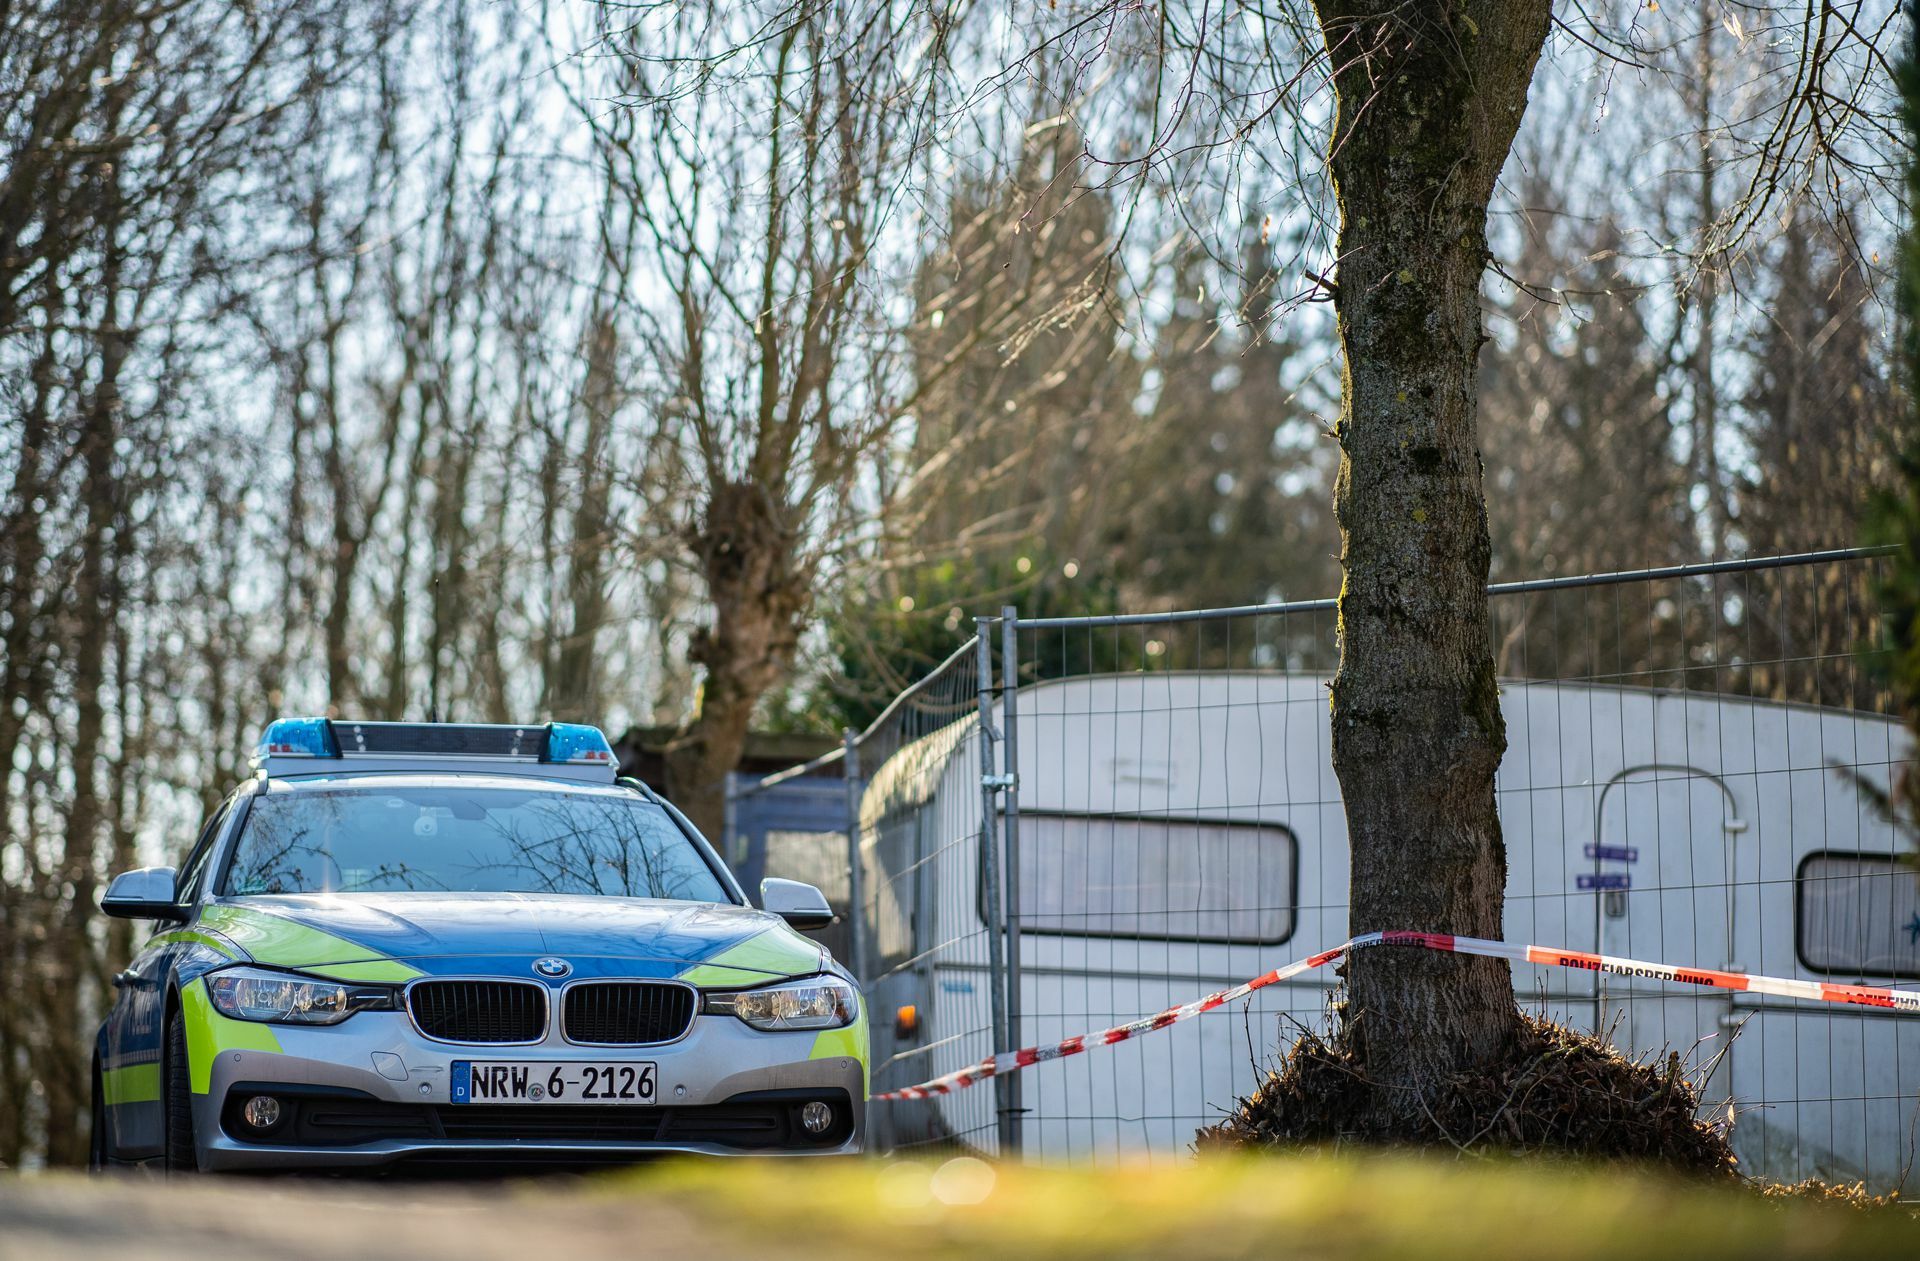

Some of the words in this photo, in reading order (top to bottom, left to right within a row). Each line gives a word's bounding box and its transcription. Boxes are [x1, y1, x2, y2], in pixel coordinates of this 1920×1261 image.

[457, 1086, 465, 1096] D
[471, 1066, 529, 1098] NRW
[547, 1066, 654, 1099] 6-2126
